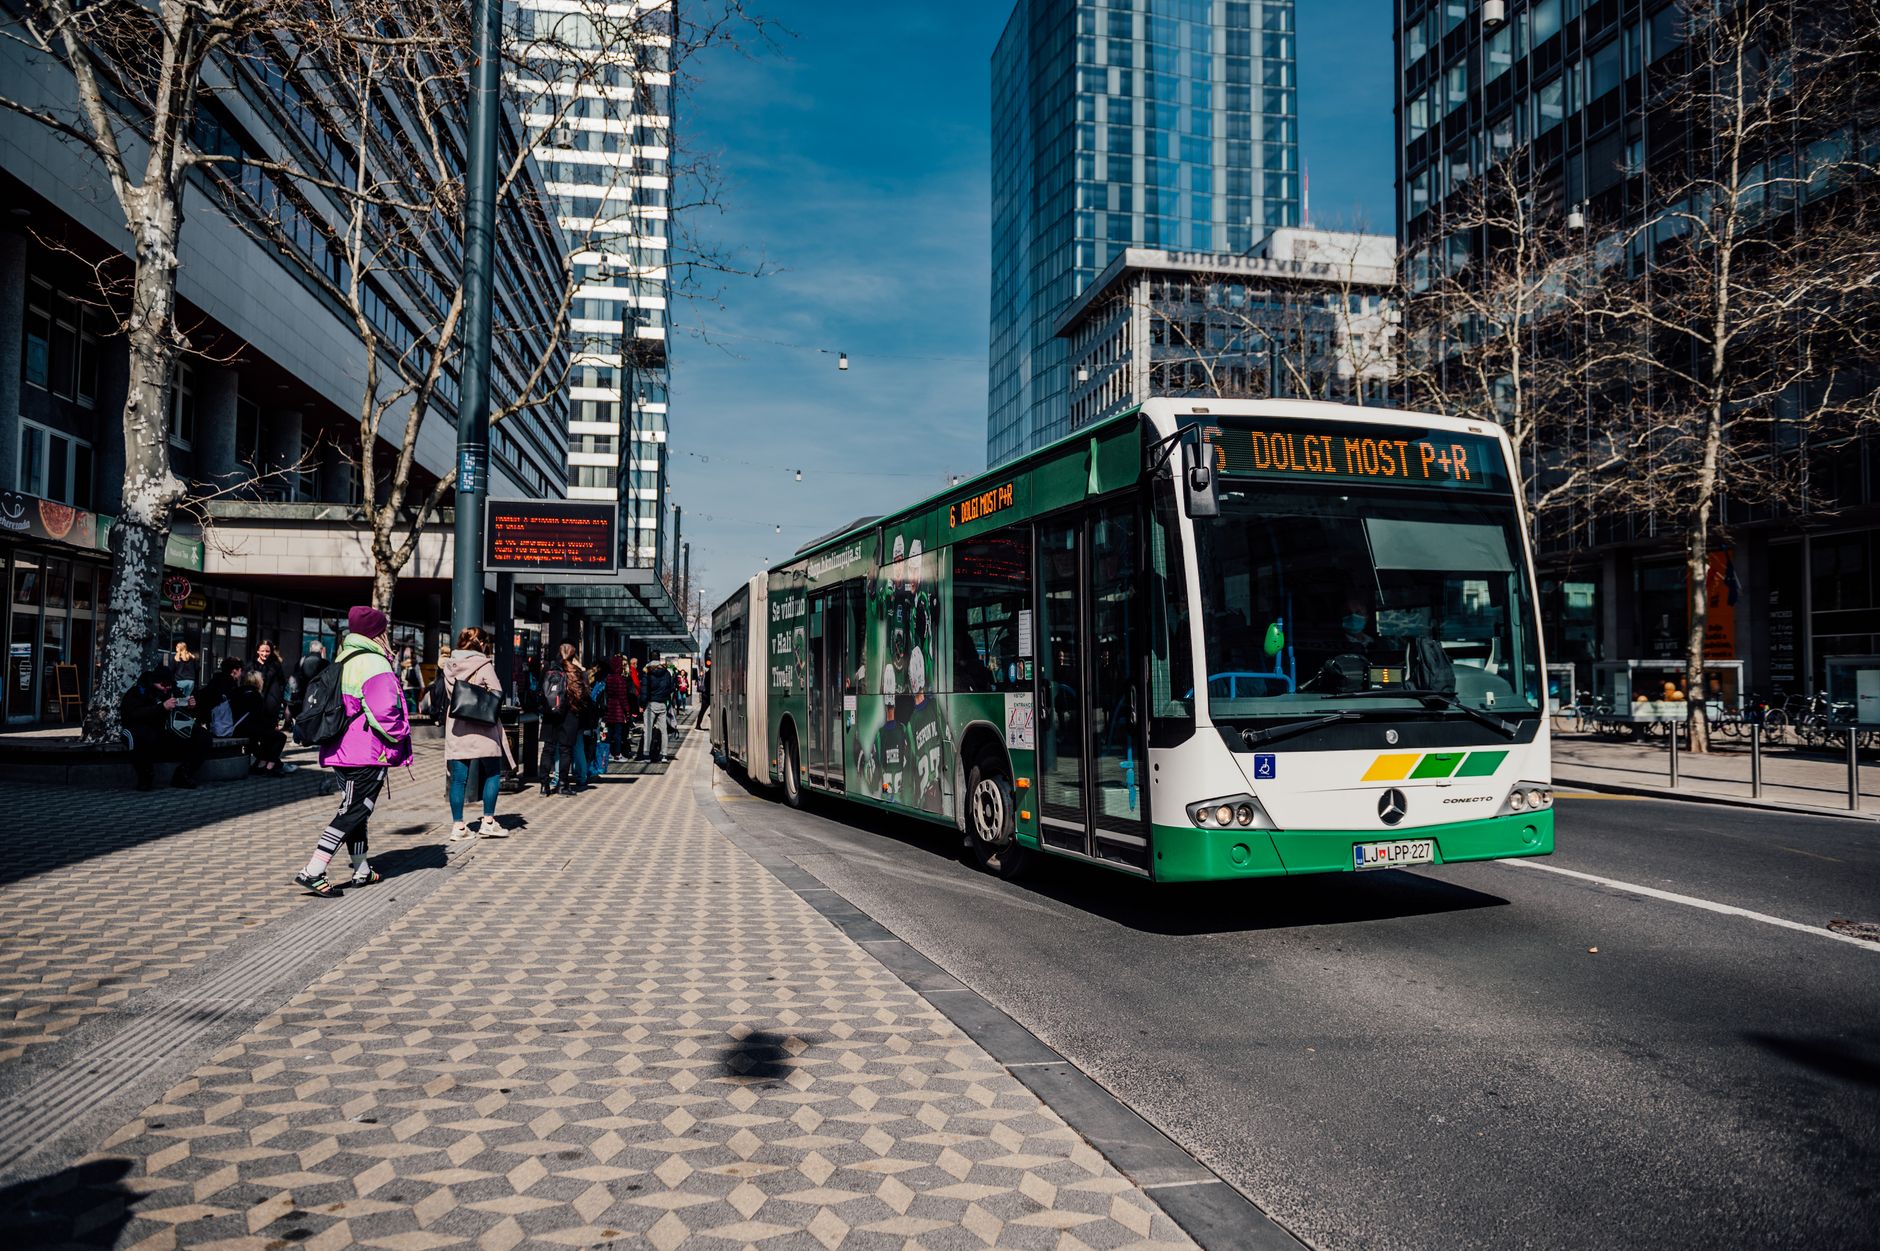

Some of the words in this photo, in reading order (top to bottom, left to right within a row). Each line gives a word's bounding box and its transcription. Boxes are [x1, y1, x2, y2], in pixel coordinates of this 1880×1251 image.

[1251, 431, 1337, 473] DOLGI
[1343, 436, 1409, 477] MOST
[1418, 442, 1471, 481] P+R
[949, 505, 956, 529] 6
[961, 497, 979, 523] DOLGI
[980, 489, 997, 517] MOST
[998, 483, 1013, 510] P+R
[772, 601, 781, 622] Se
[771, 637, 777, 655] v
[777, 630, 792, 654] Hali
[1442, 796, 1493, 804] CONECTO
[1363, 846, 1379, 863] LJ
